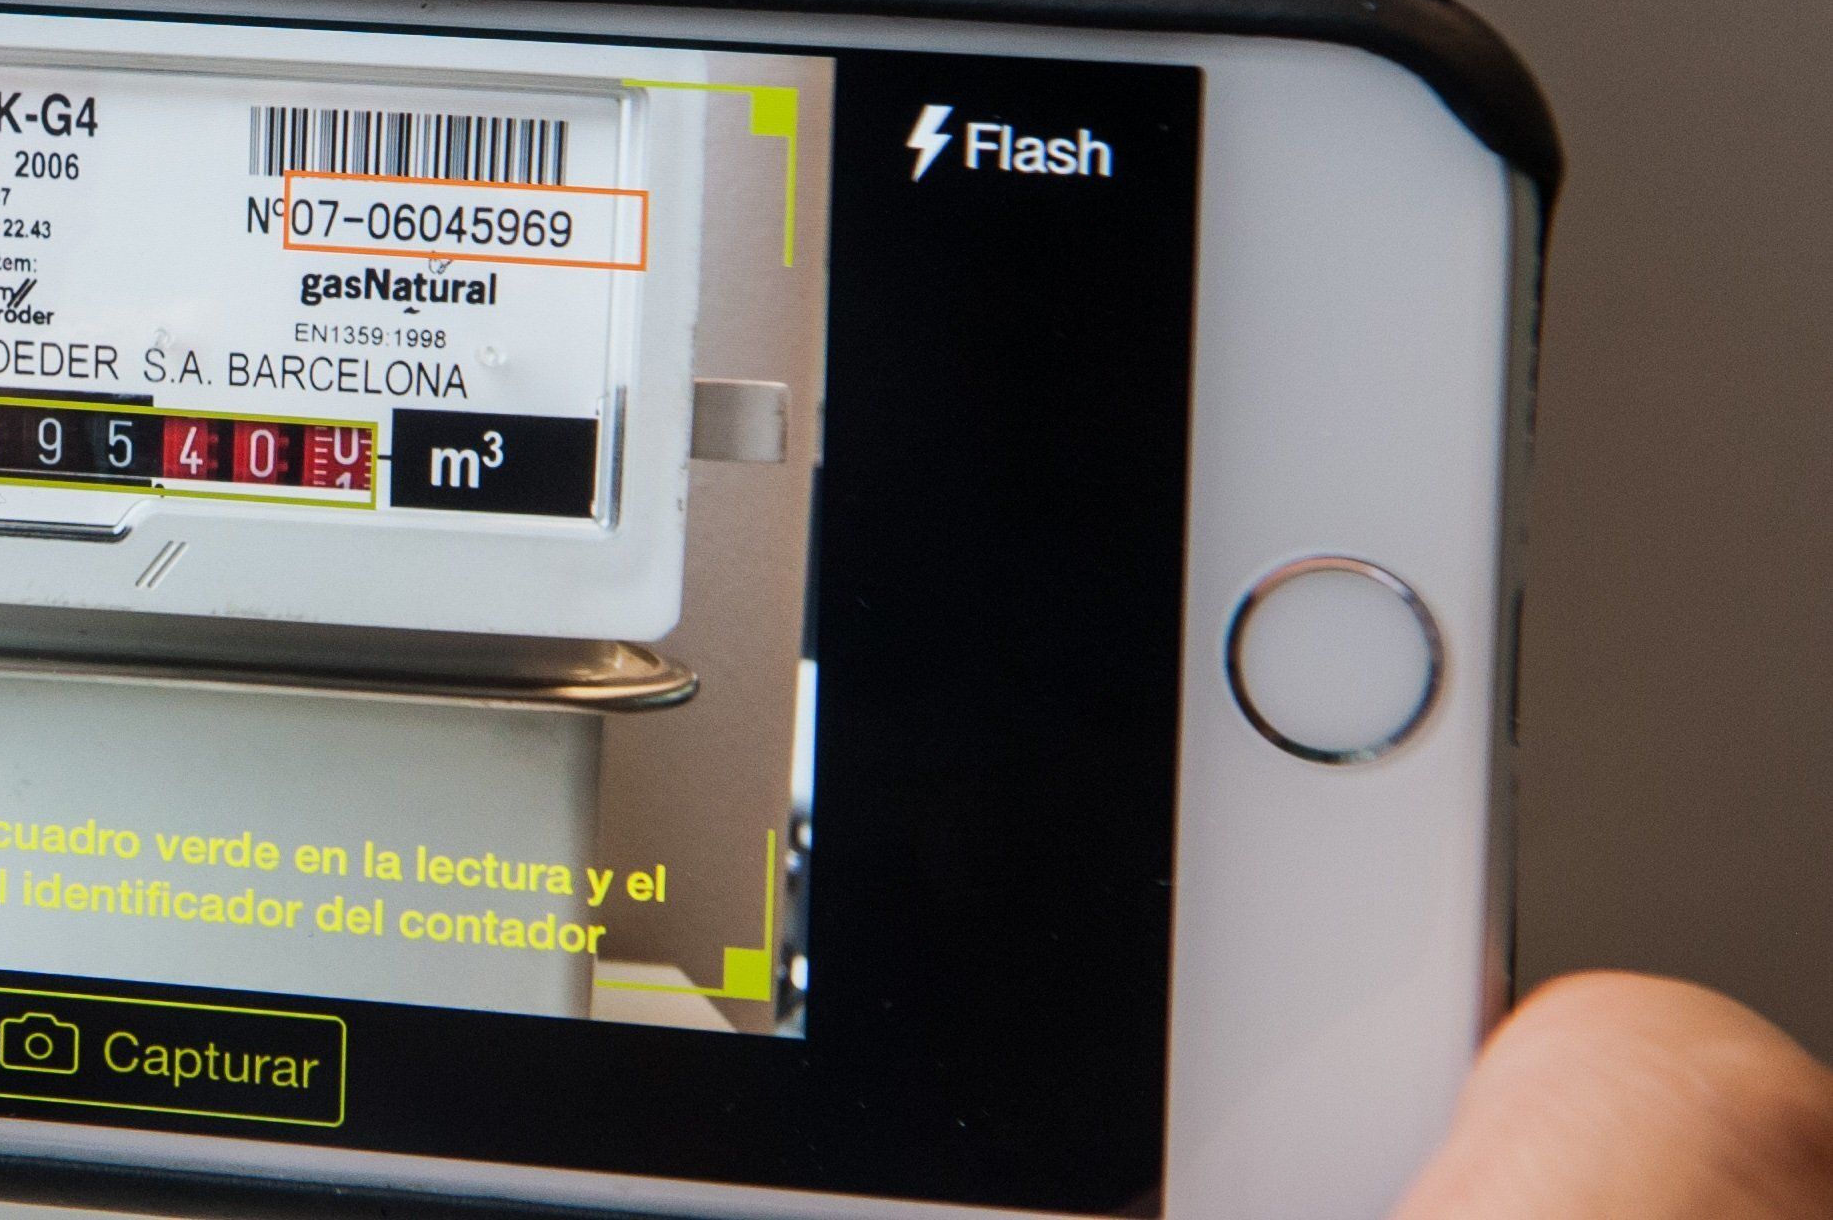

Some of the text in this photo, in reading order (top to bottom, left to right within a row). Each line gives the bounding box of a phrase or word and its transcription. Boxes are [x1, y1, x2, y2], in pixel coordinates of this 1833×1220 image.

[14, 150, 80, 180] 2006
[965, 122, 1112, 177] Flash
[300, 268, 498, 307] gasNatural
[295, 323, 447, 350] EN1359:1998
[143, 347, 213, 385] S.A.
[229, 353, 468, 399] BARCELONA
[428, 430, 505, 490] m³
[155, 831, 280, 871] verde
[294, 844, 348, 876] en
[364, 841, 402, 881] la
[416, 845, 573, 896] lectura
[586, 867, 614, 907] y
[626, 863, 666, 902] el
[23, 870, 303, 929] identificador
[315, 895, 384, 936] del
[399, 910, 607, 954] contador
[103, 1031, 320, 1088] Capturar
